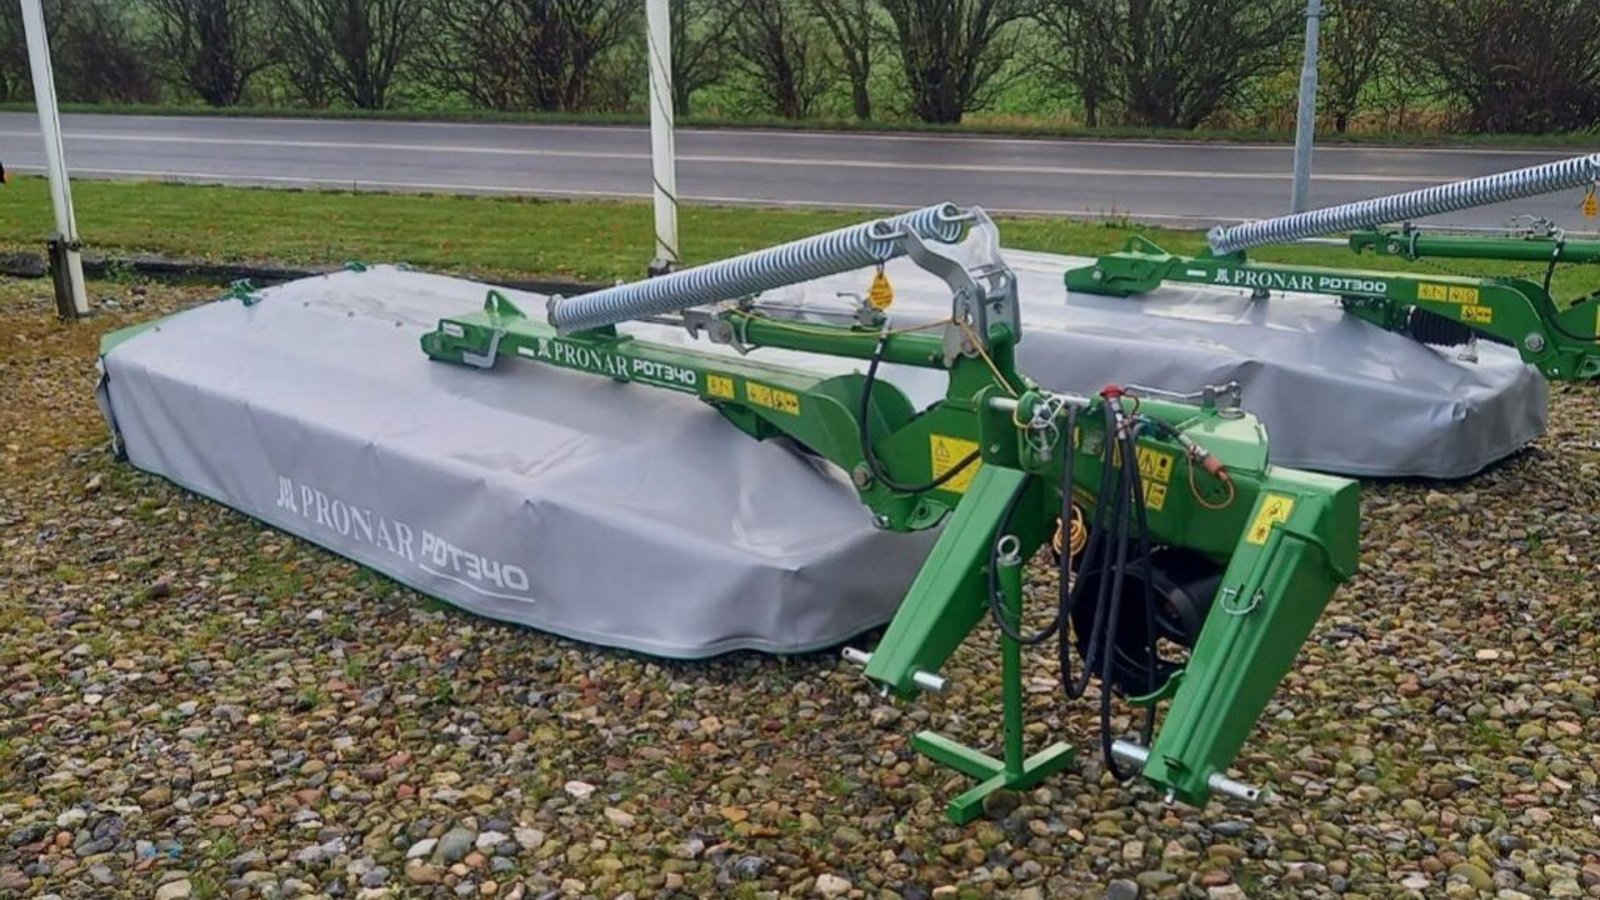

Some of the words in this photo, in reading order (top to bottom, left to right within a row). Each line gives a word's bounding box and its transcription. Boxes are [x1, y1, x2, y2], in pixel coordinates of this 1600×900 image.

[1234, 270, 1314, 291] PRONAR
[1319, 277, 1388, 293] PDT300
[554, 341, 630, 378] PRONAR
[632, 358, 696, 385] PDT340
[301, 484, 414, 562] PRONAR
[421, 530, 529, 591] PDT340
